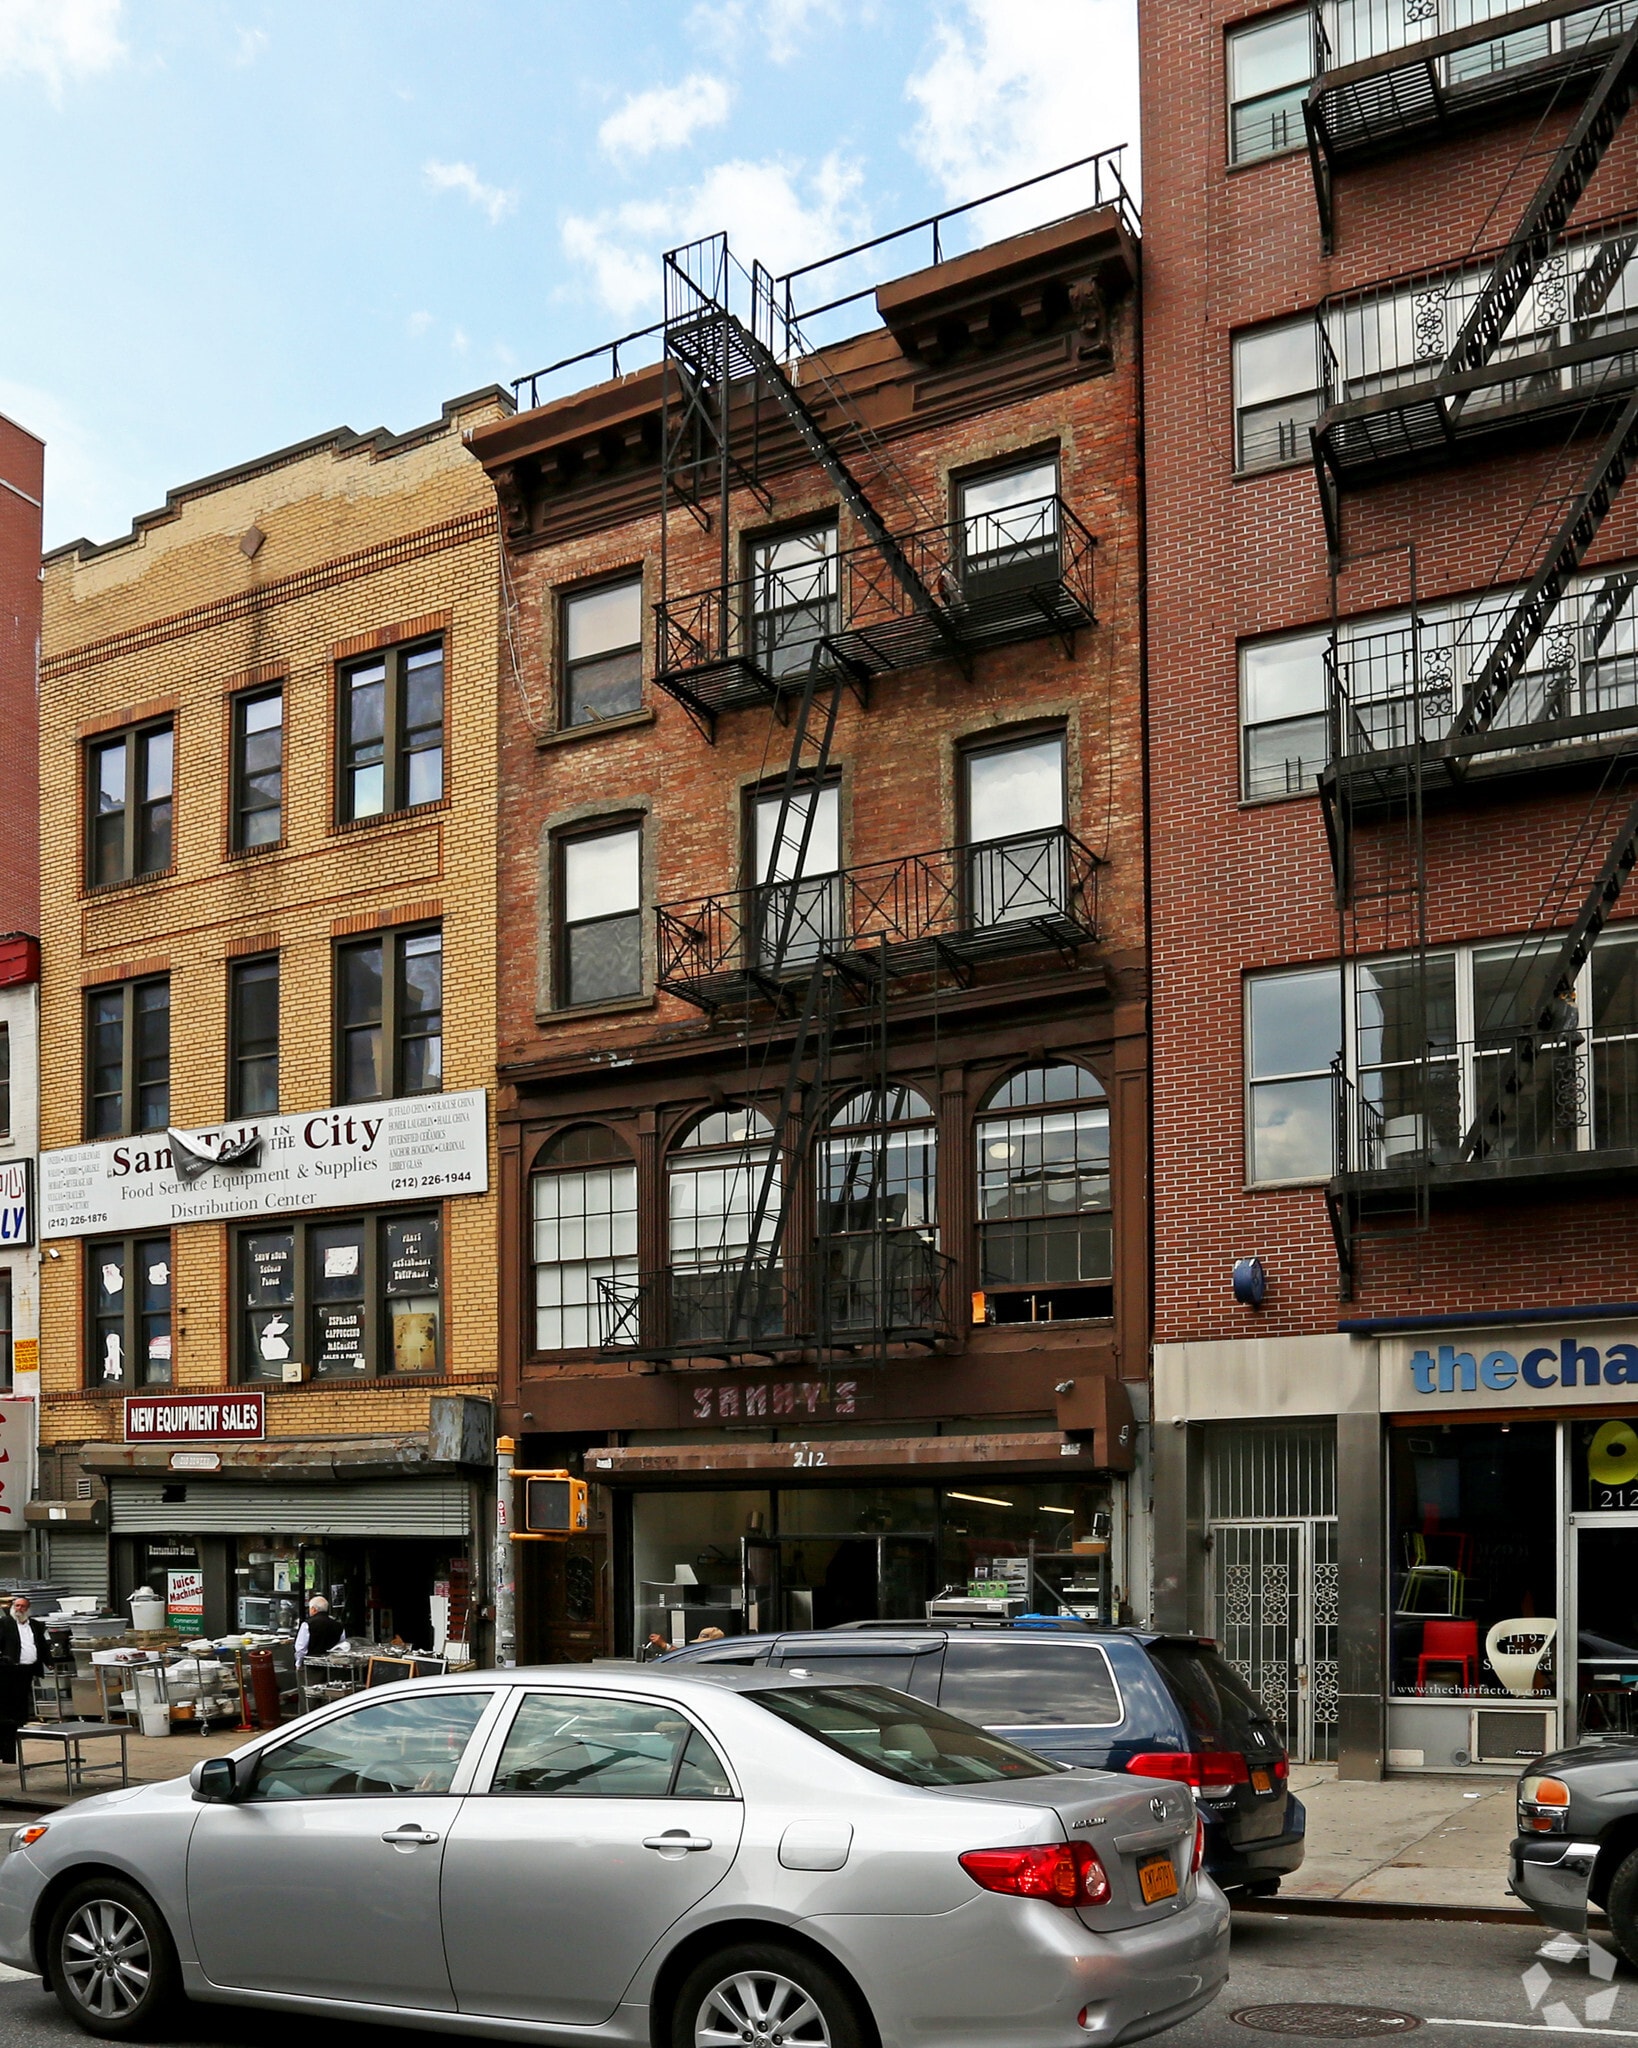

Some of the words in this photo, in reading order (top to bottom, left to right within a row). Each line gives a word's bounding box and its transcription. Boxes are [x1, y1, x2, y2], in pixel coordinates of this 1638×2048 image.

[273, 1125, 290, 1136] IN
[303, 1114, 384, 1152] City
[269, 1136, 296, 1150] THE
[121, 1182, 154, 1200] Food
[158, 1179, 208, 1196] Service
[212, 1167, 290, 1192] Equipment
[296, 1163, 309, 1179] &
[314, 1156, 378, 1180] Supplies
[391, 1177, 418, 1190] (212)
[421, 1171, 471, 1185] 226-1944
[171, 1196, 258, 1218] Distribution
[265, 1193, 318, 1208] Center
[47, 1216, 69, 1229] (212)
[70, 1212, 108, 1225] 226-1876
[130, 1407, 155, 1432] NEW
[156, 1405, 219, 1433] EQUIPMENT
[221, 1404, 258, 1430] SALES
[793, 1452, 828, 1467] 212
[172, 1575, 195, 1591] Juice
[169, 1585, 205, 1603] Machines
